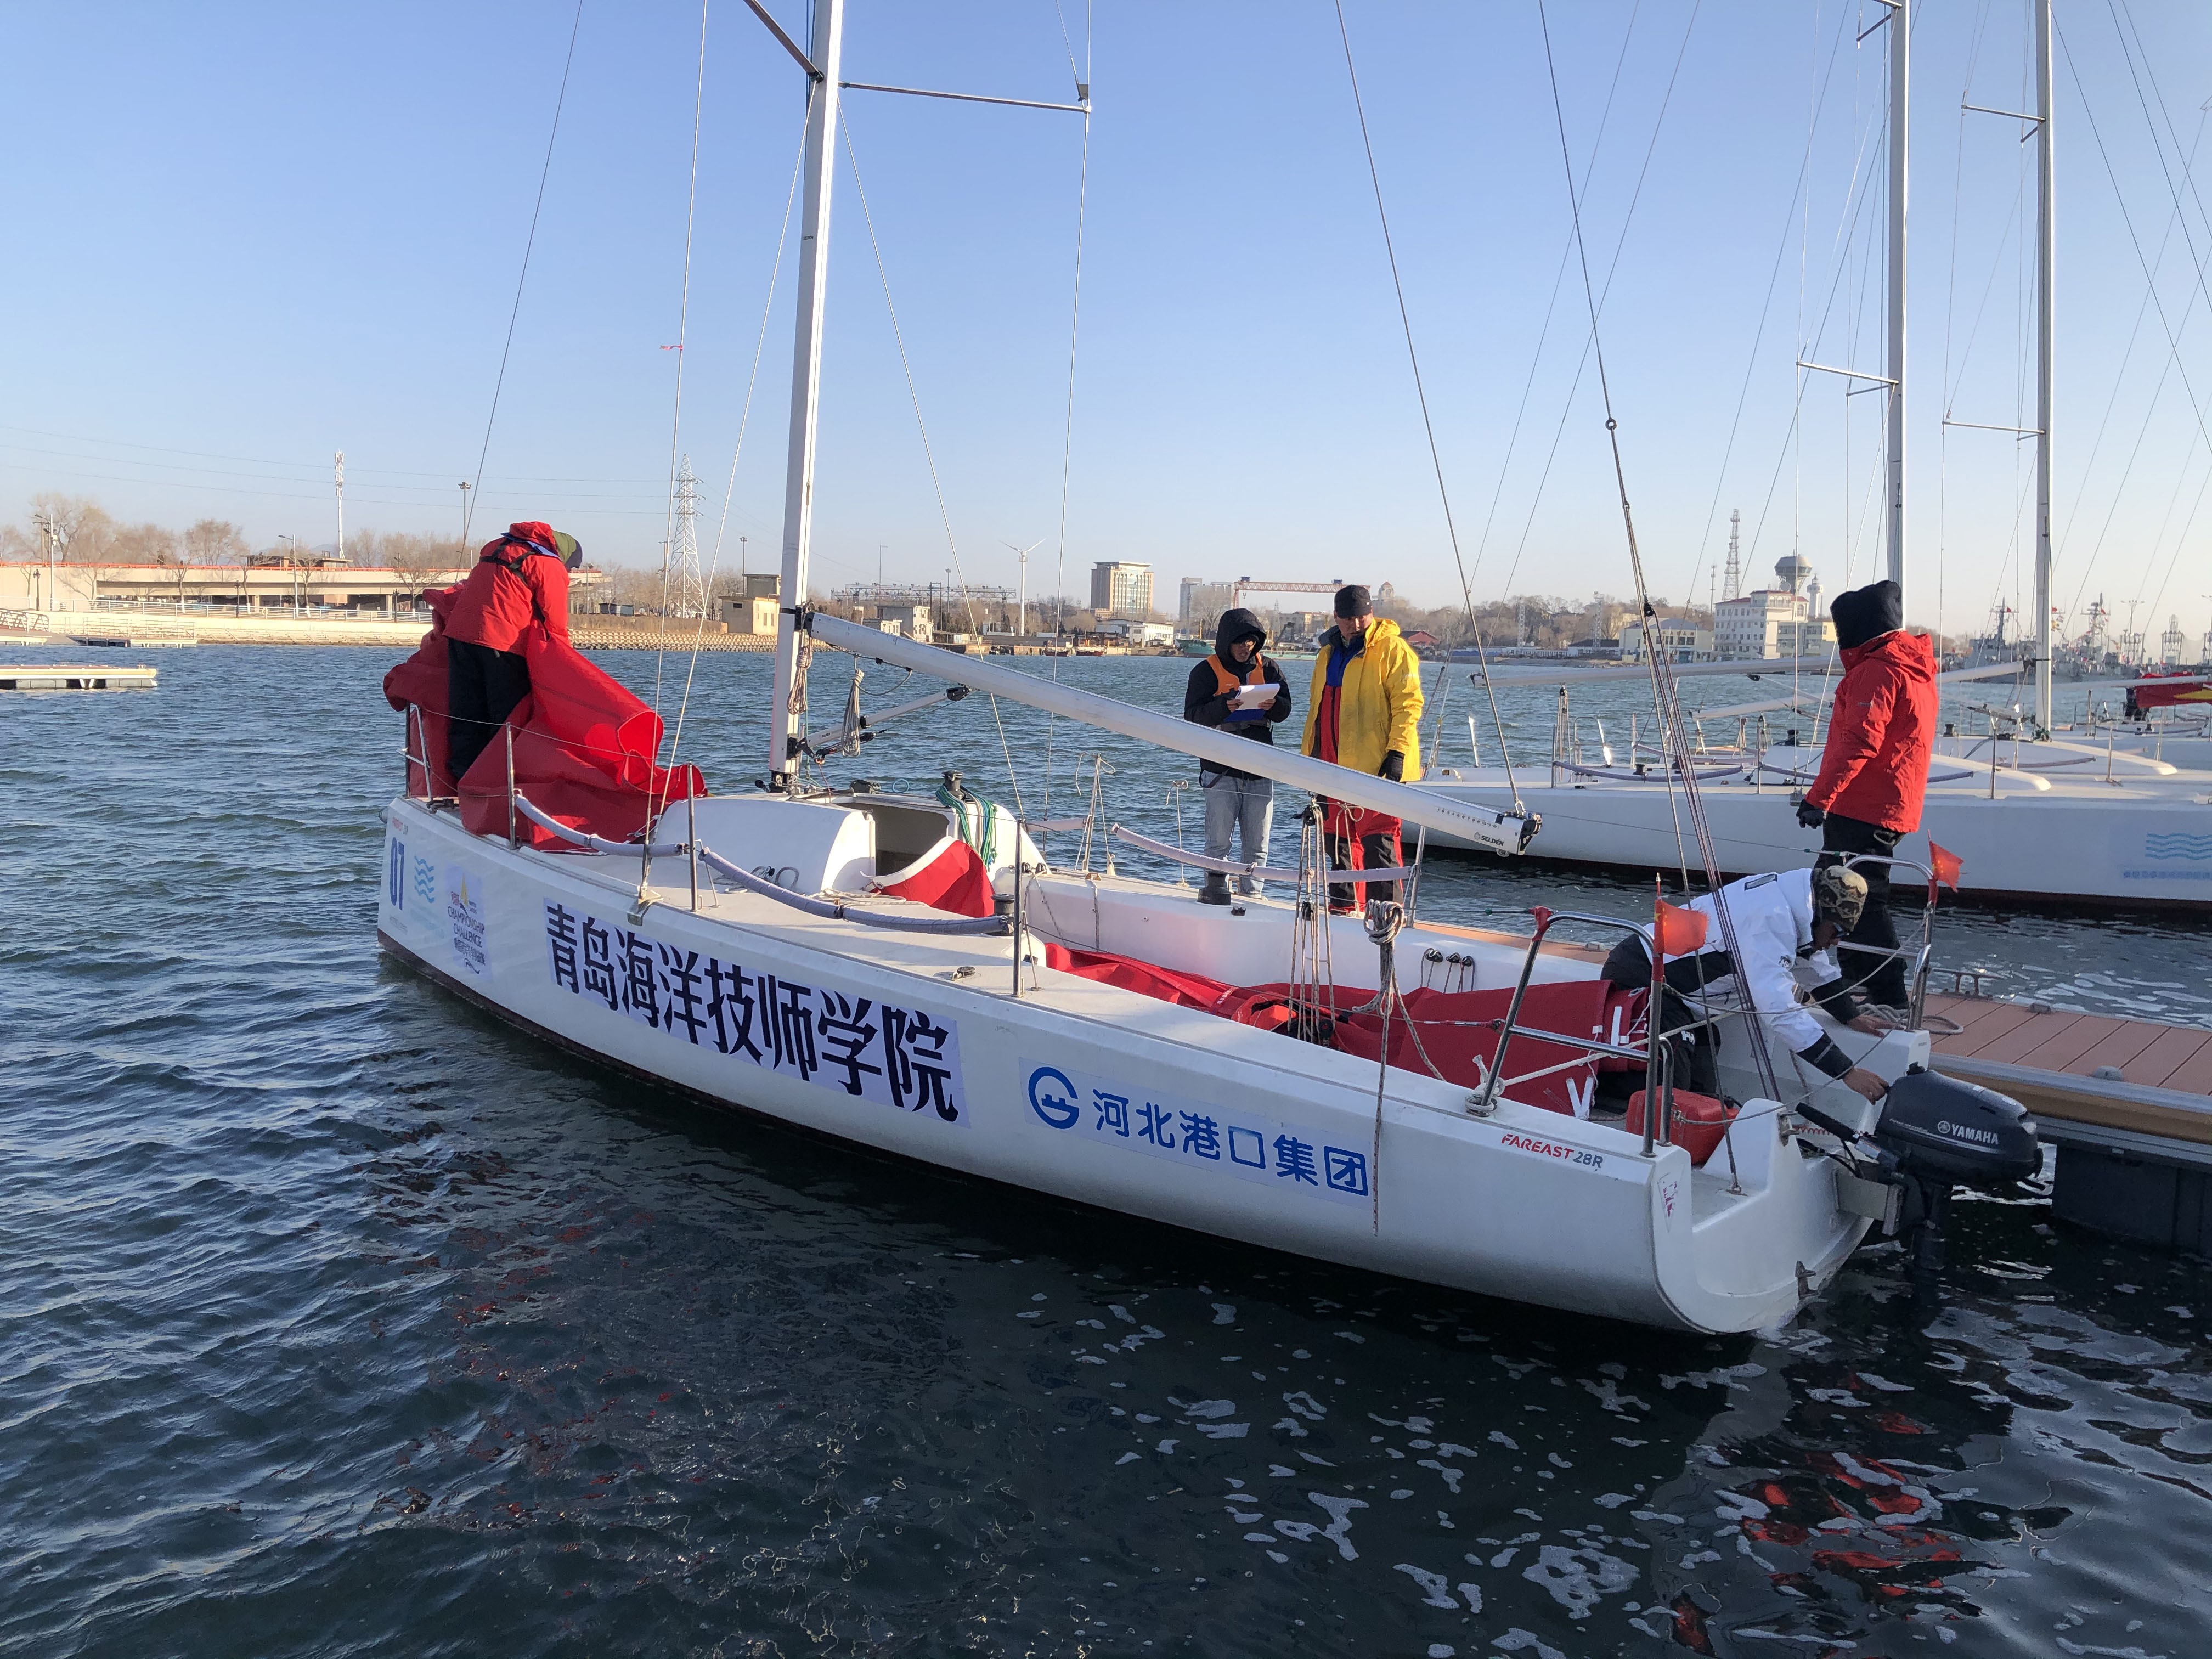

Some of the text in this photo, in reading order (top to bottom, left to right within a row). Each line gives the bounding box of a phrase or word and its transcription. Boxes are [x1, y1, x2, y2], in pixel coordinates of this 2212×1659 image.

[448, 906, 485, 935] CHAMPIONSHIP
[453, 923, 483, 948] CHALLENGE
[546, 904, 959, 1122] 青岛海洋技师学院
[1092, 1088, 1369, 1197] 河北港口集团
[1951, 1124, 1999, 1145] YAMAHA
[1500, 1133, 1604, 1169] FAREAST 28R
